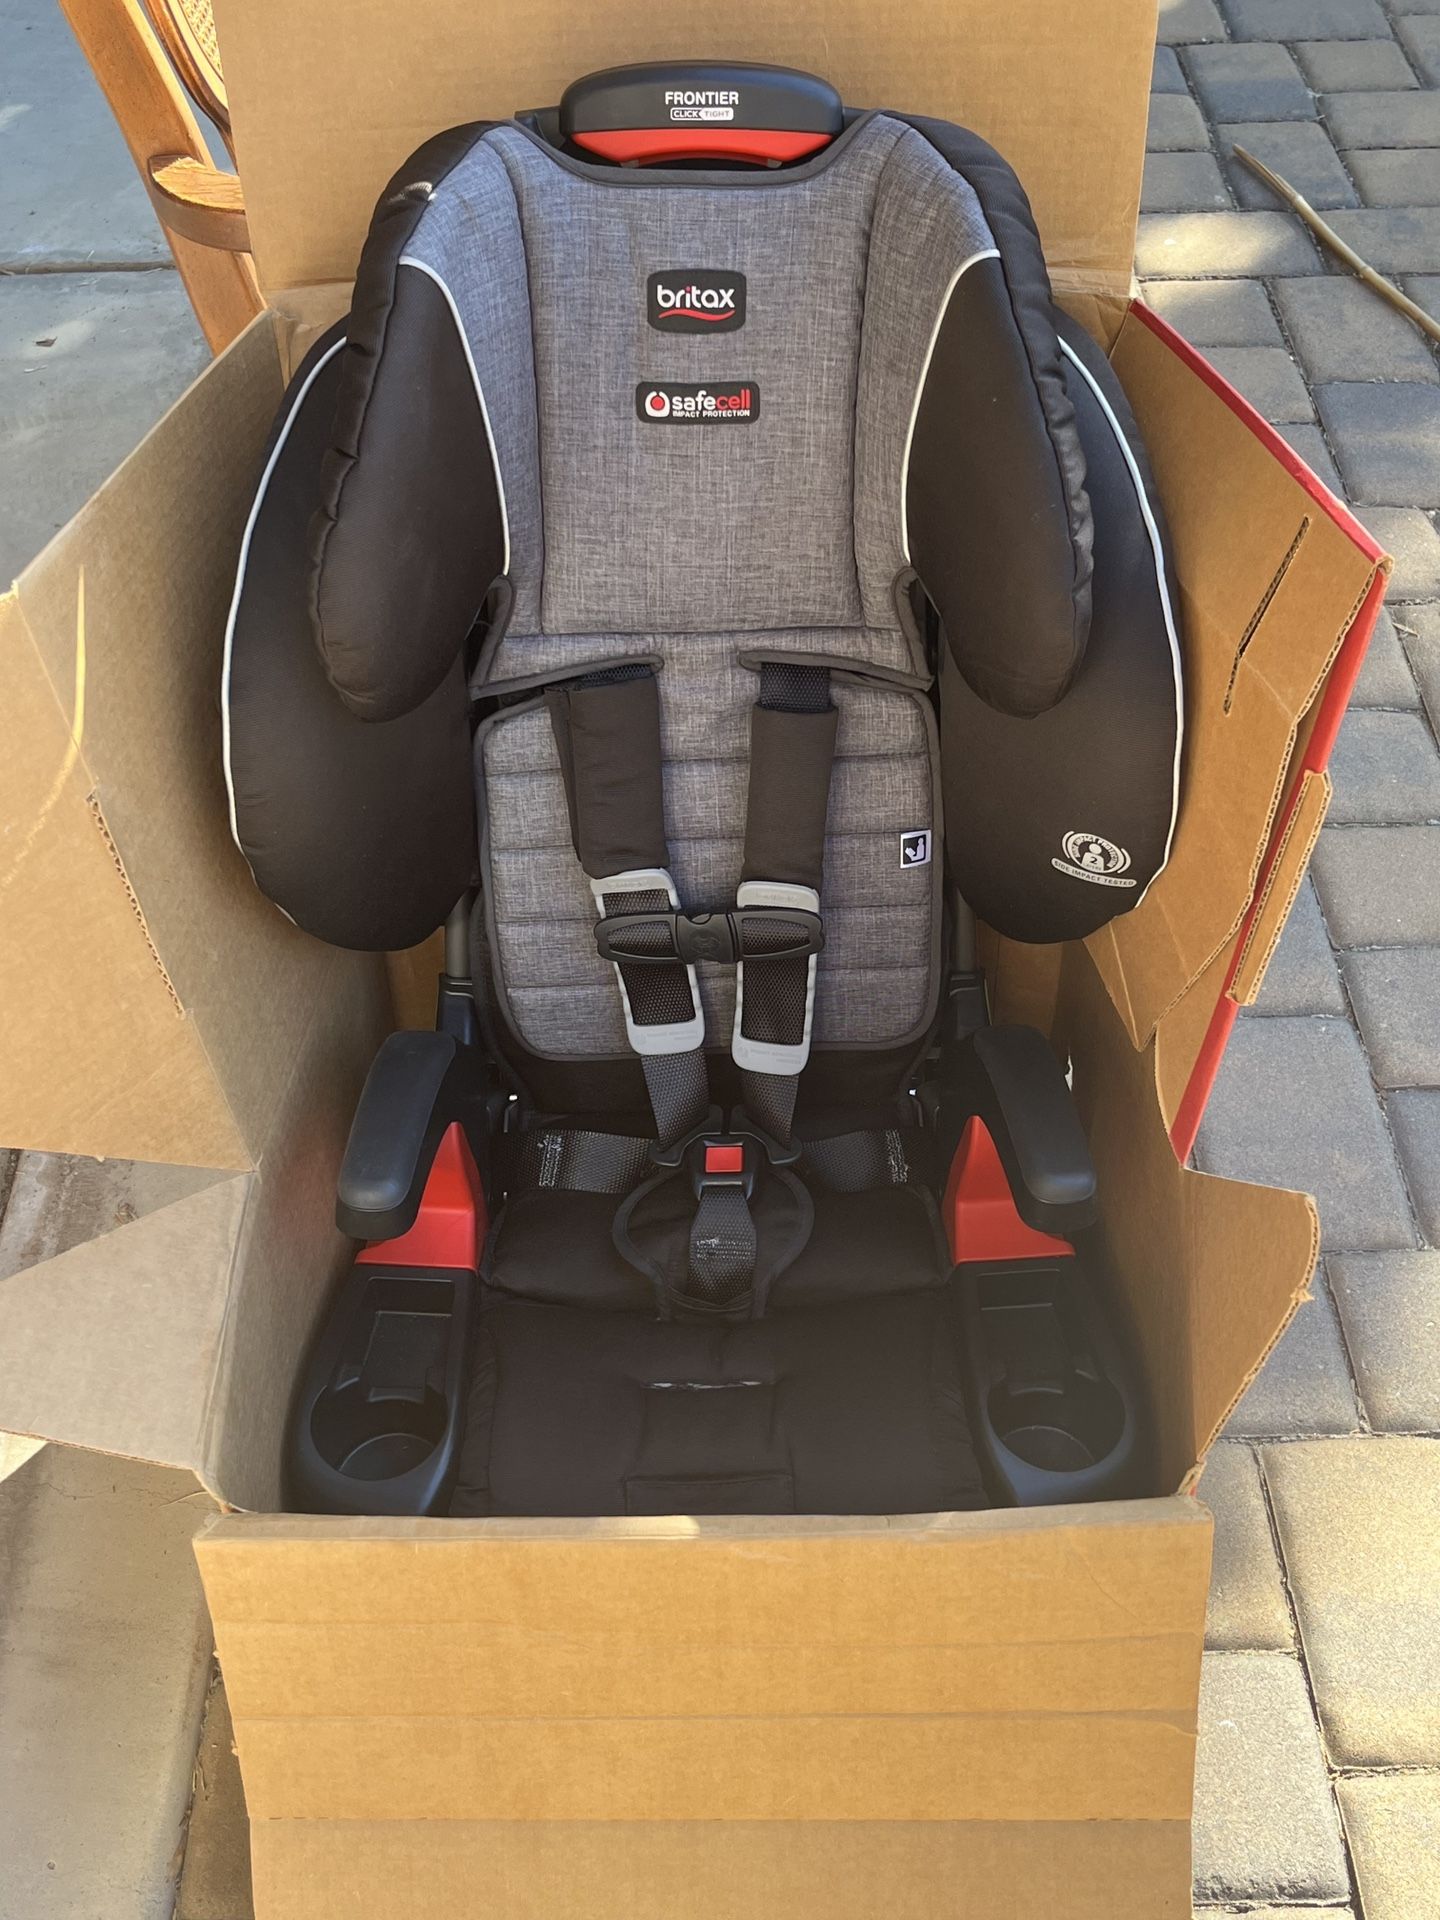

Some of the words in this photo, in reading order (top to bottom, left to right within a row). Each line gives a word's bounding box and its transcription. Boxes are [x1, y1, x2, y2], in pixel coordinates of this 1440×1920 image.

[664, 91, 739, 105] FRONTIER
[673, 110, 699, 119] CLICK
[703, 110, 731, 118] TIGHT
[656, 284, 735, 308] britax
[672, 389, 751, 411] safecell
[672, 409, 700, 418] IMPACT
[702, 409, 750, 418] PROTECTION
[1090, 856, 1099, 865] 2
[1054, 860, 1071, 872] SIDE
[1071, 868, 1100, 882] IMPACT
[1104, 879, 1135, 887] TESTED
